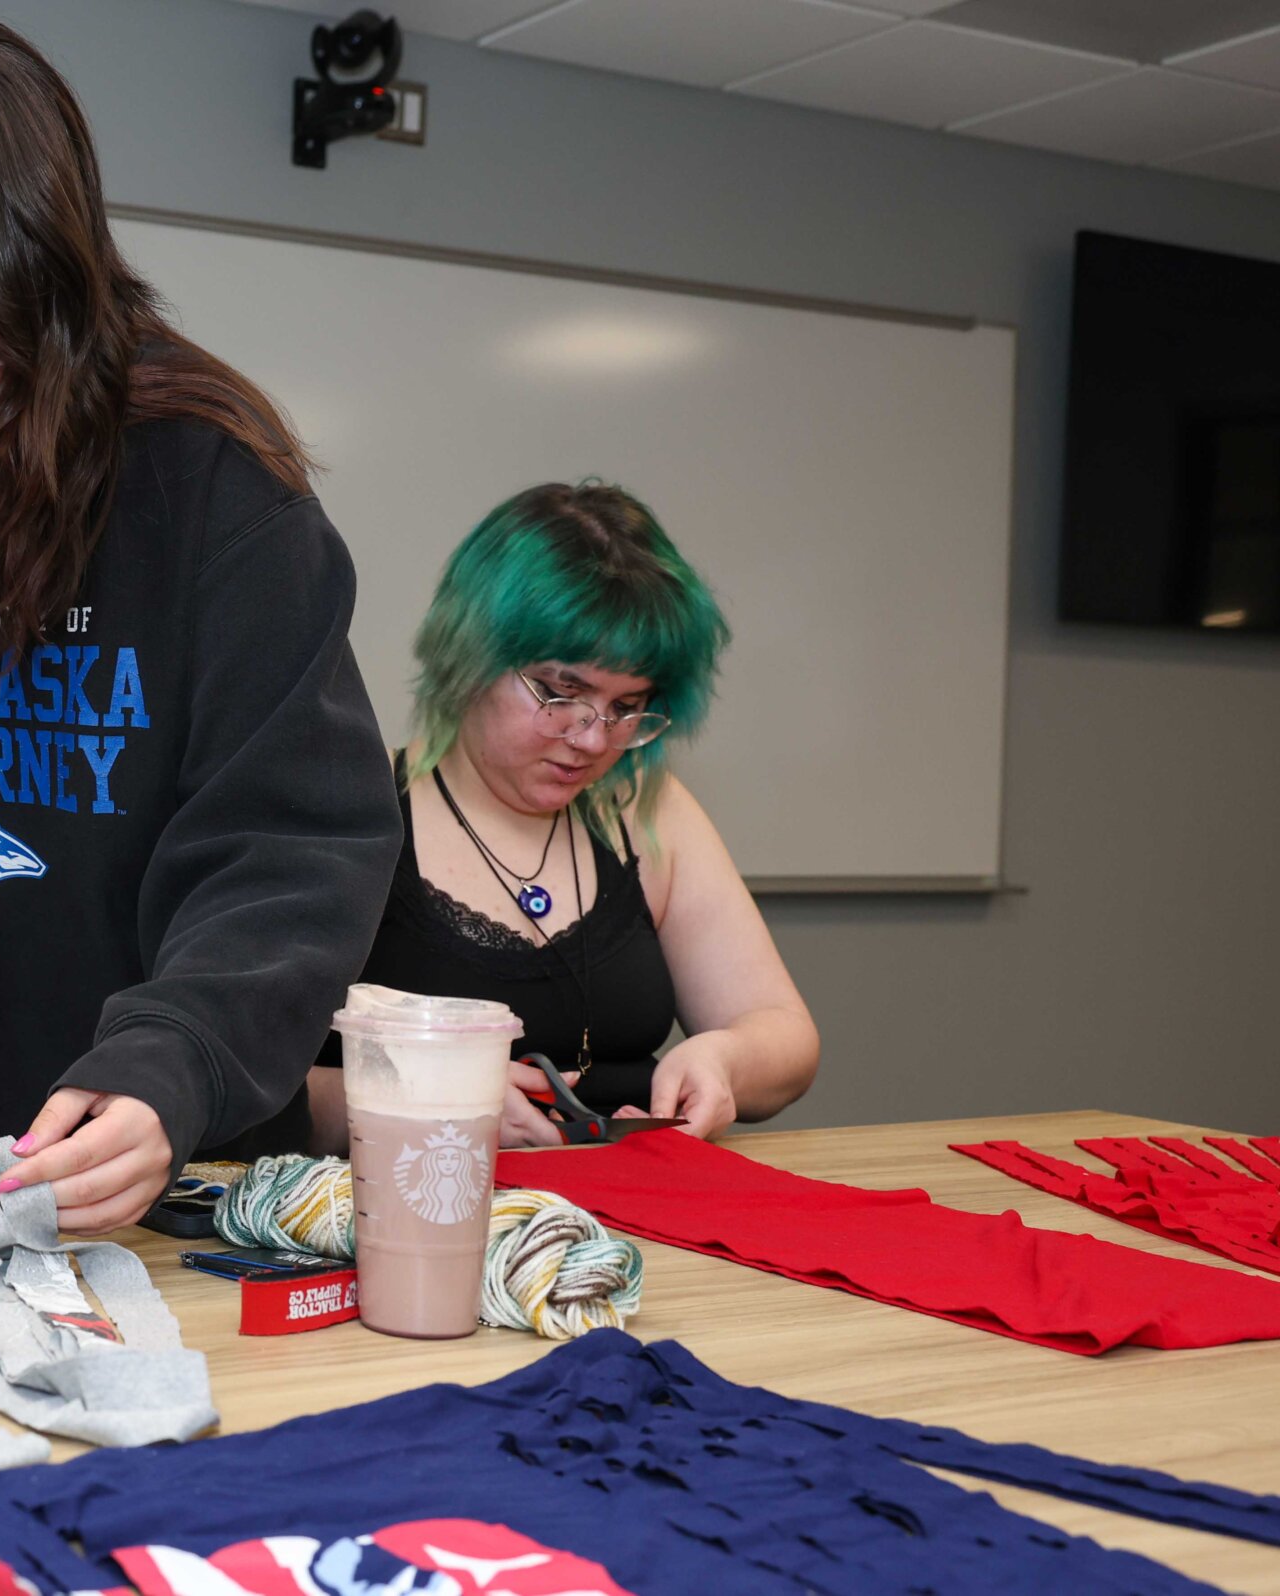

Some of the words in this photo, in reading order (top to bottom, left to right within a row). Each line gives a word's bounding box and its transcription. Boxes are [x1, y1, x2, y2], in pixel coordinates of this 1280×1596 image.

[66, 606, 92, 633] OF
[305, 1283, 342, 1303] SUPPLY
[289, 1297, 342, 1320] TRACTOR
